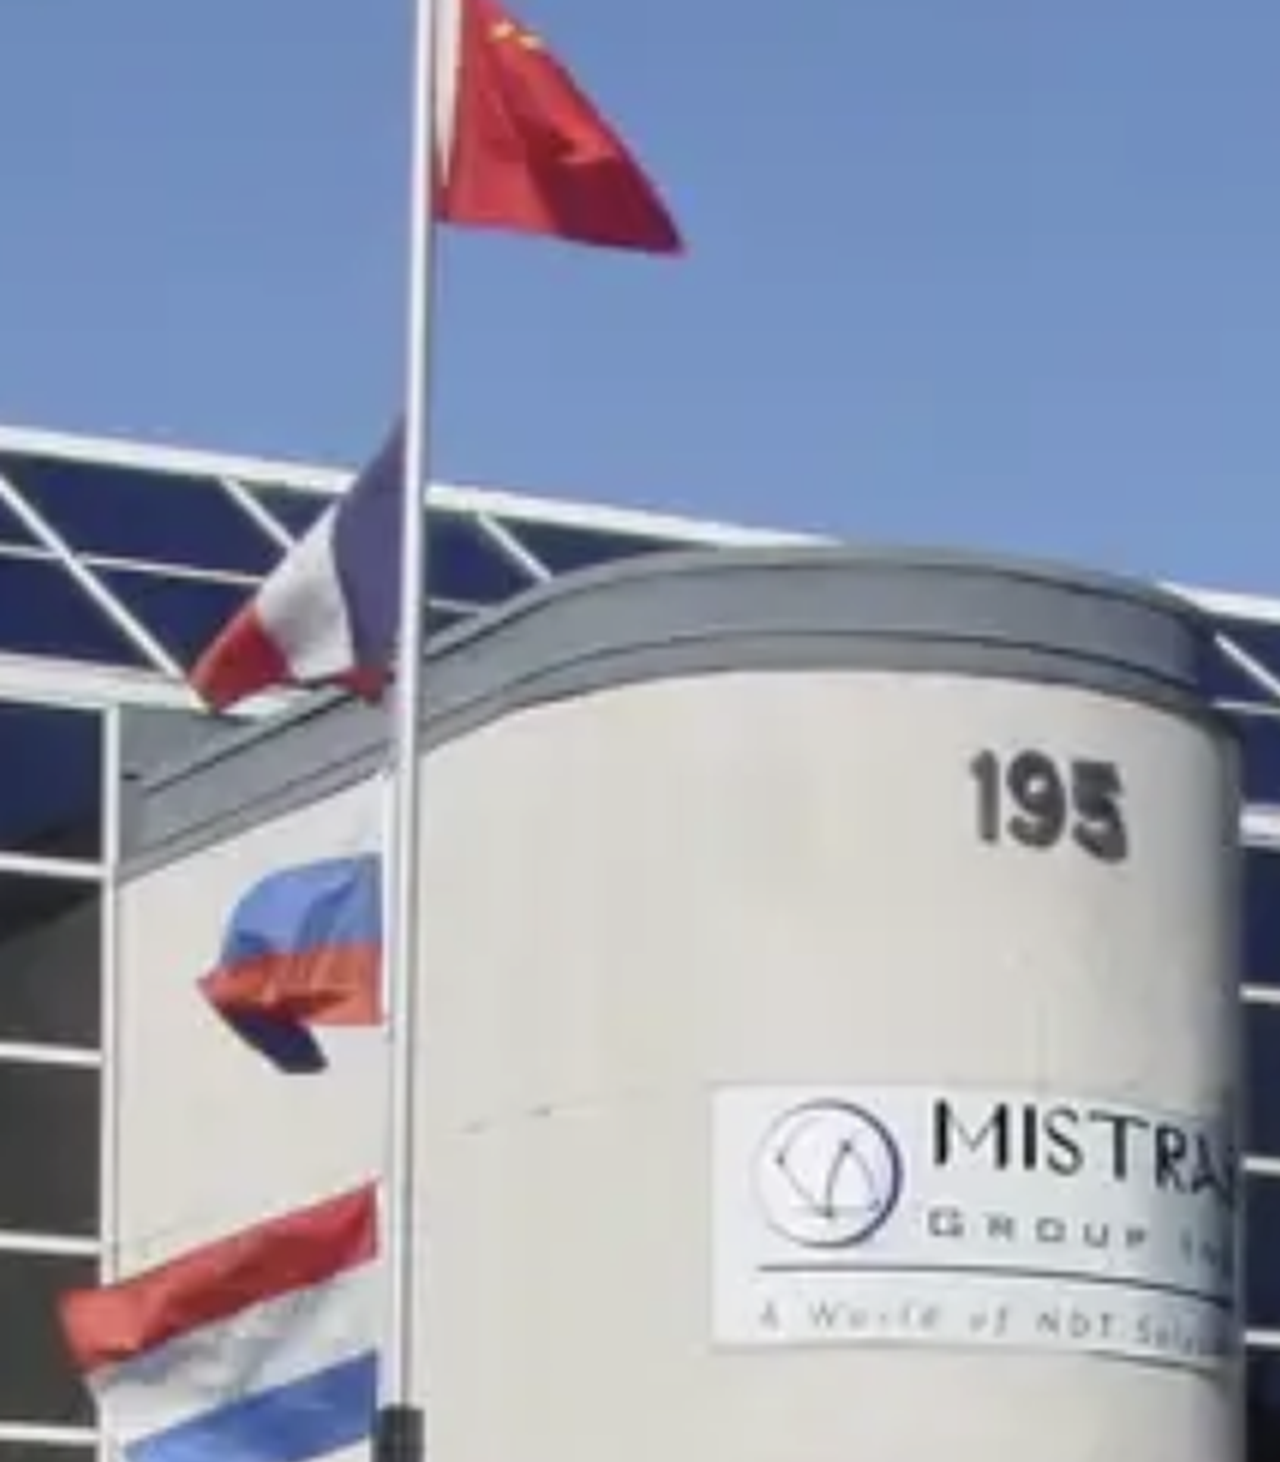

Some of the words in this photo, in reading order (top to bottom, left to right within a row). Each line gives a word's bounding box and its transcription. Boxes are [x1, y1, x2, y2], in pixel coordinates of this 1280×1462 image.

[969, 748, 1128, 863] 195
[927, 1206, 1147, 1248] GROUP
[758, 1300, 782, 1333] A
[1036, 1310, 1112, 1340] NDT
